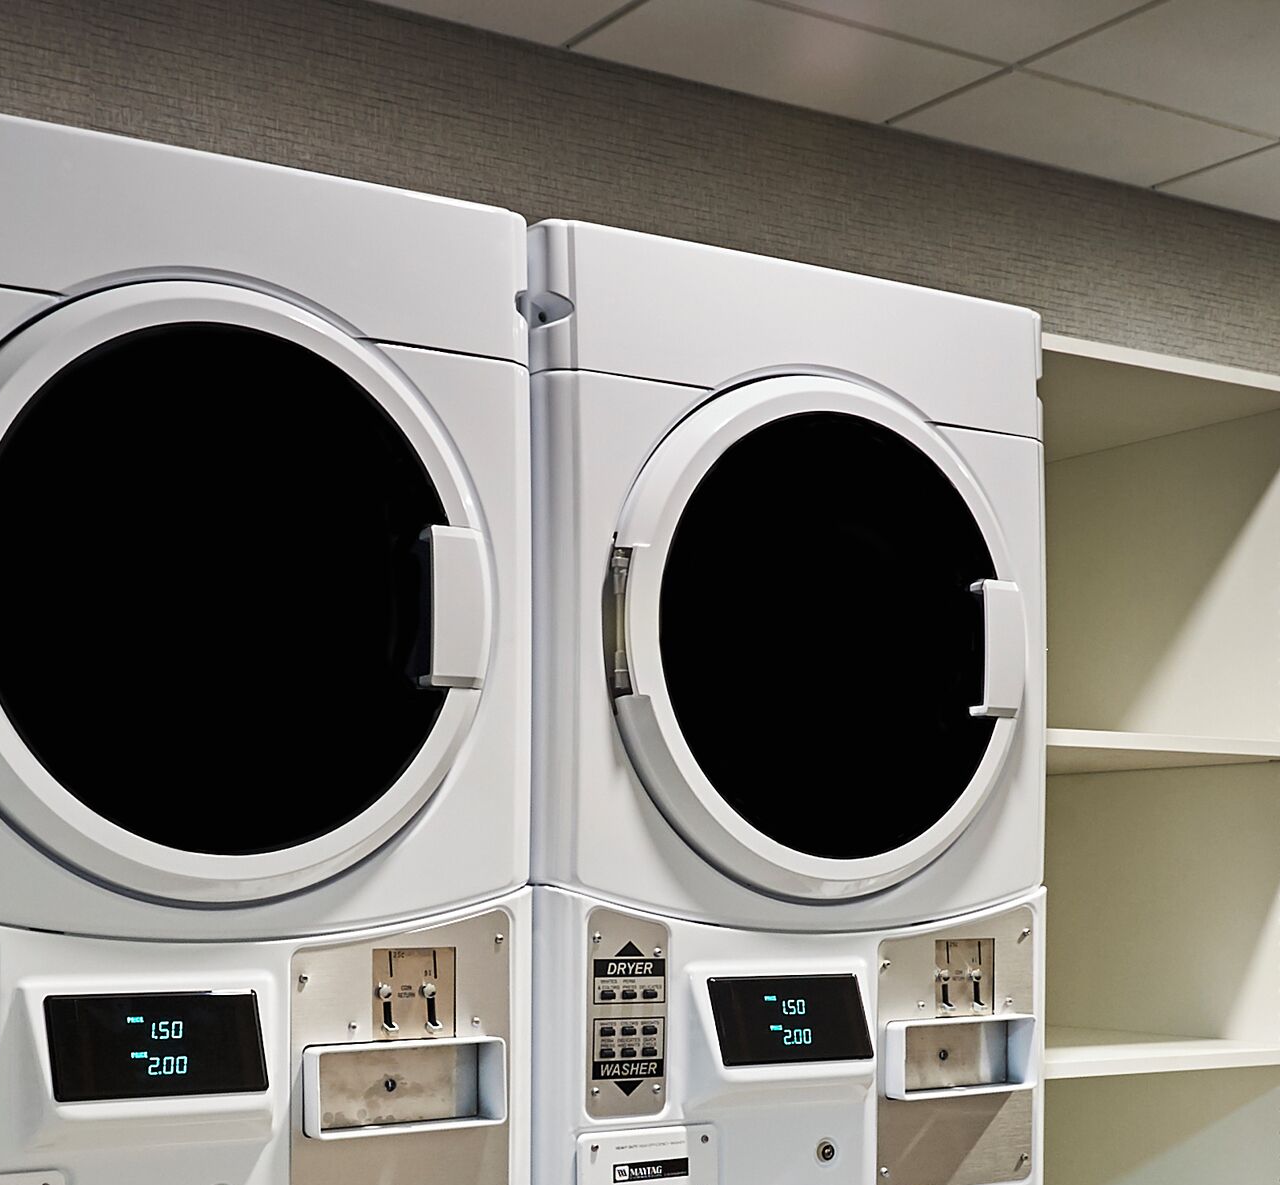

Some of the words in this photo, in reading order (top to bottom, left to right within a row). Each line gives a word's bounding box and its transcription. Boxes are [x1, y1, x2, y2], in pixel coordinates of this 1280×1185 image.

[607, 962, 653, 975] DRYER
[151, 1020, 183, 1040] 1.50
[783, 1028, 812, 1045] 2.00
[148, 1055, 188, 1076] 2.00
[600, 1062, 658, 1077] WASHER
[629, 1165, 663, 1177] MAYTAG
